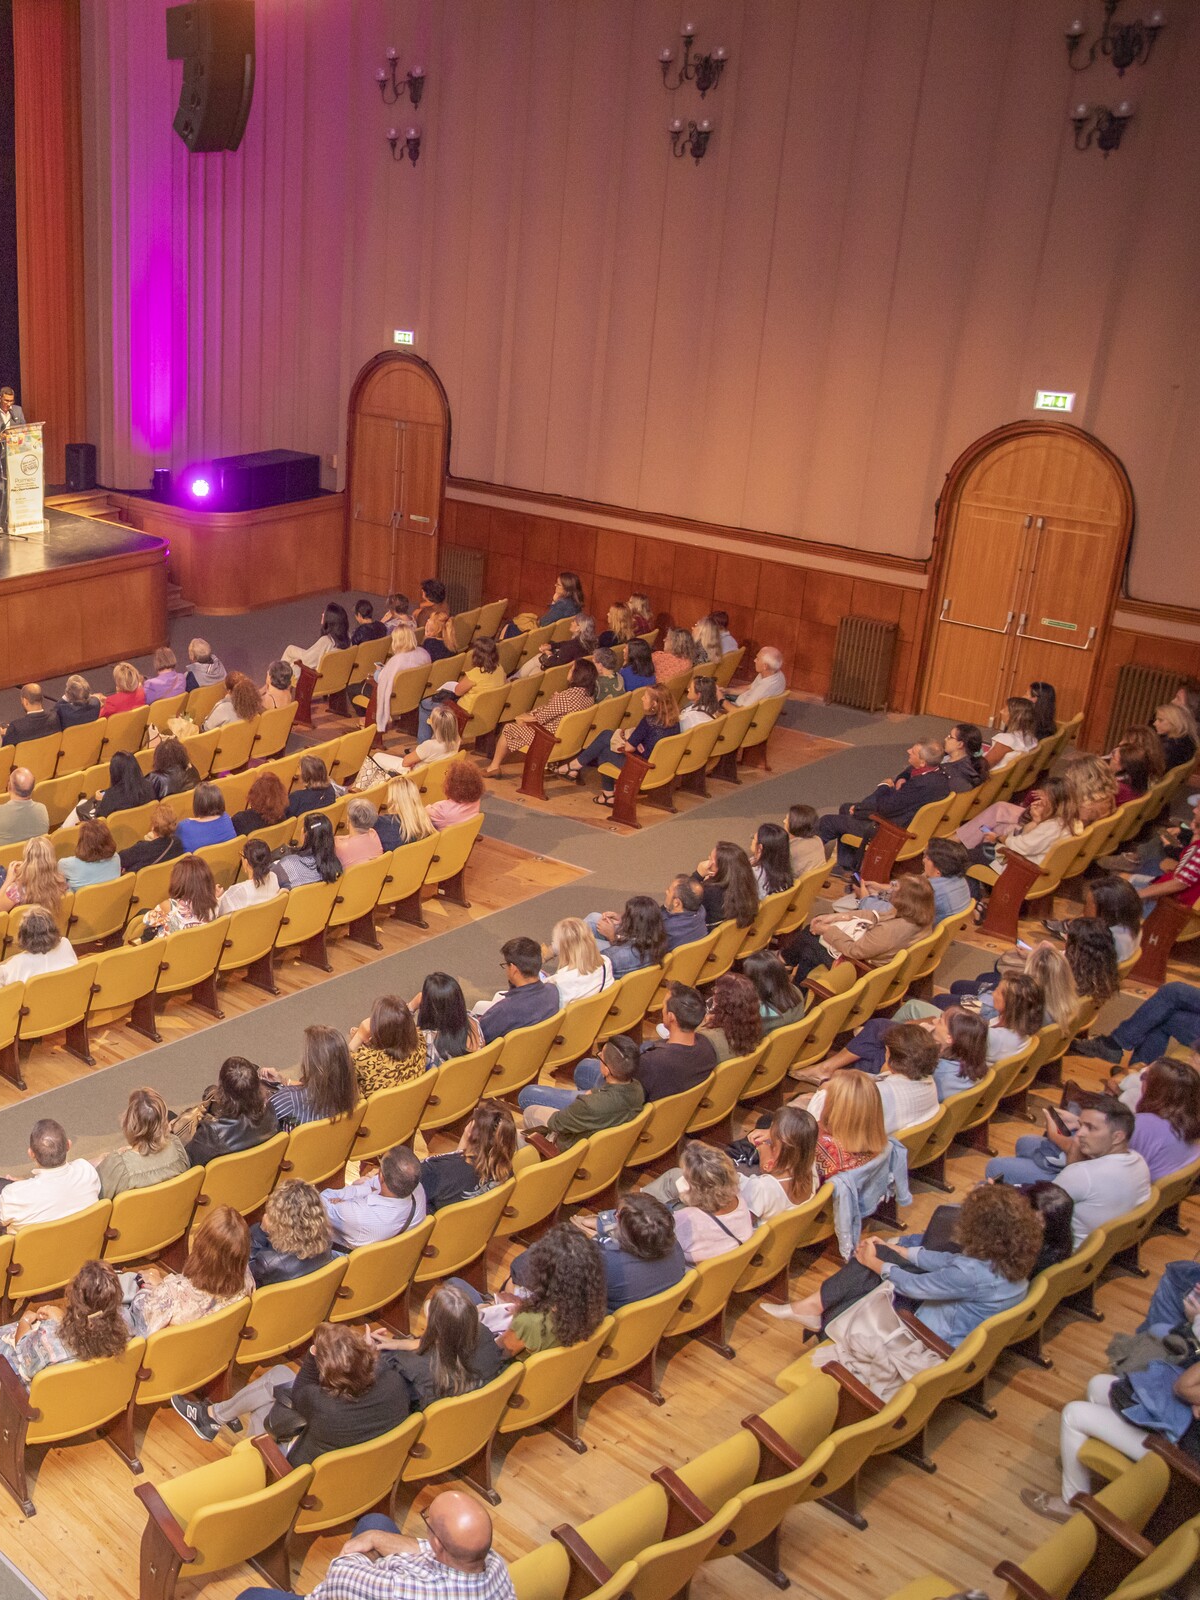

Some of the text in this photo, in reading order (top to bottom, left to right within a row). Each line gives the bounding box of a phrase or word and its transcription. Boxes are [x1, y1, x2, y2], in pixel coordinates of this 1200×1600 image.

[874, 855, 882, 865] F
[1148, 933, 1160, 946] H
[186, 1404, 198, 1421] N
